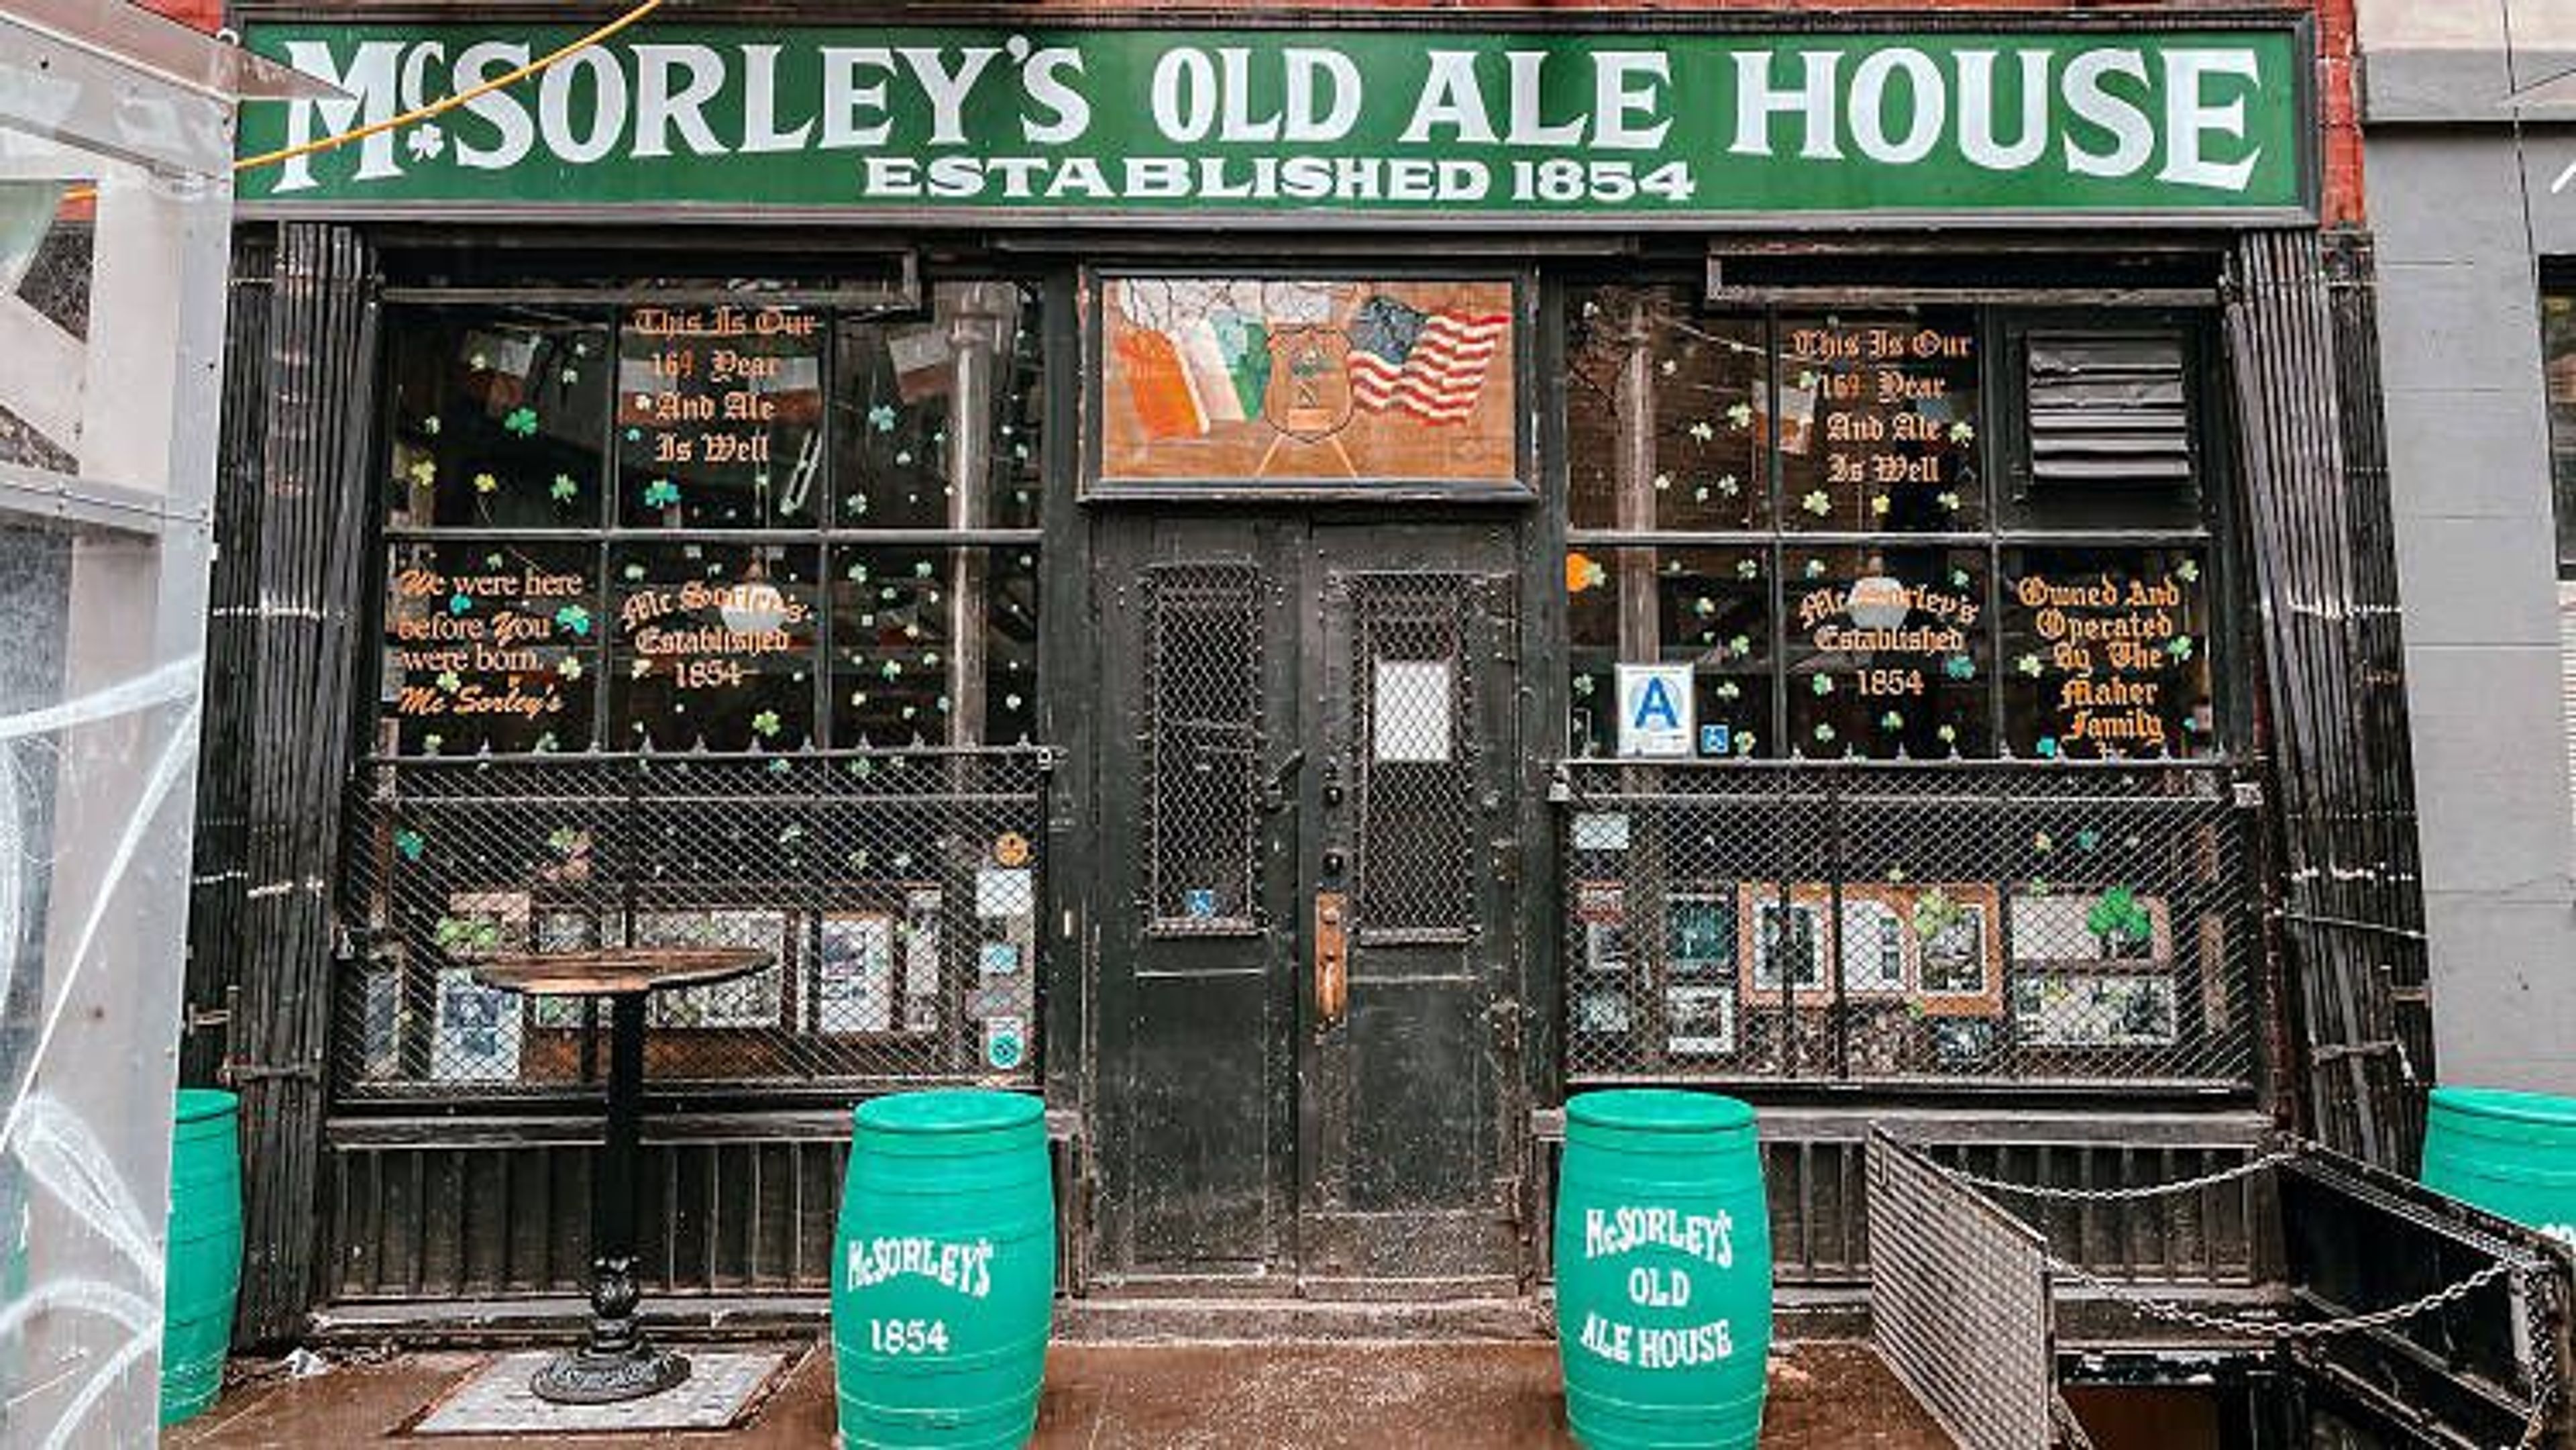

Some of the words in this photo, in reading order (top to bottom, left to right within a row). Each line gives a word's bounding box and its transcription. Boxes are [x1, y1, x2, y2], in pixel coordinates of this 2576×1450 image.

[1151, 46, 1362, 145] OLD
[1399, 48, 1675, 146] ALE
[1727, 47, 2262, 193] HOUSE
[863, 156, 1489, 201] ESTABLISHED
[1512, 160, 1695, 201] 1854
[635, 309, 702, 340] This
[711, 307, 746, 335] Is
[755, 310, 815, 334] Our
[1792, 329, 1860, 364] This
[1868, 329, 1904, 358] Is
[1912, 329, 1972, 358] Our
[655, 391, 715, 420] And
[723, 391, 775, 420] Ale
[1827, 411, 1884, 441] And
[1892, 411, 1941, 441] Ale
[655, 433, 692, 462] Is
[701, 433, 769, 462] Well
[1827, 452, 1865, 482] Is
[1872, 452, 1939, 482] Well
[397, 570, 444, 595] We
[453, 575, 519, 595] were
[525, 568, 582, 595] here
[2019, 573, 2117, 607] Owned
[2124, 574, 2179, 606] And
[398, 611, 484, 639] before
[492, 611, 551, 647] You
[636, 625, 790, 656] Established
[1814, 625, 1963, 658] Established
[2036, 607, 2172, 646] Operated
[402, 649, 468, 670] were
[675, 660, 742, 688] 1854
[2053, 641, 2092, 678] By
[2106, 640, 2163, 670] The
[1858, 669, 1925, 695] 1854
[2057, 675, 2158, 711] Maher
[1635, 677, 1678, 728] A
[2060, 707, 2165, 744] Family
[1628, 1267, 1690, 1306] OLD
[870, 1318, 949, 1354] 1854
[1580, 1312, 1633, 1365] ALE
[1639, 1319, 1732, 1368] HOUSE
